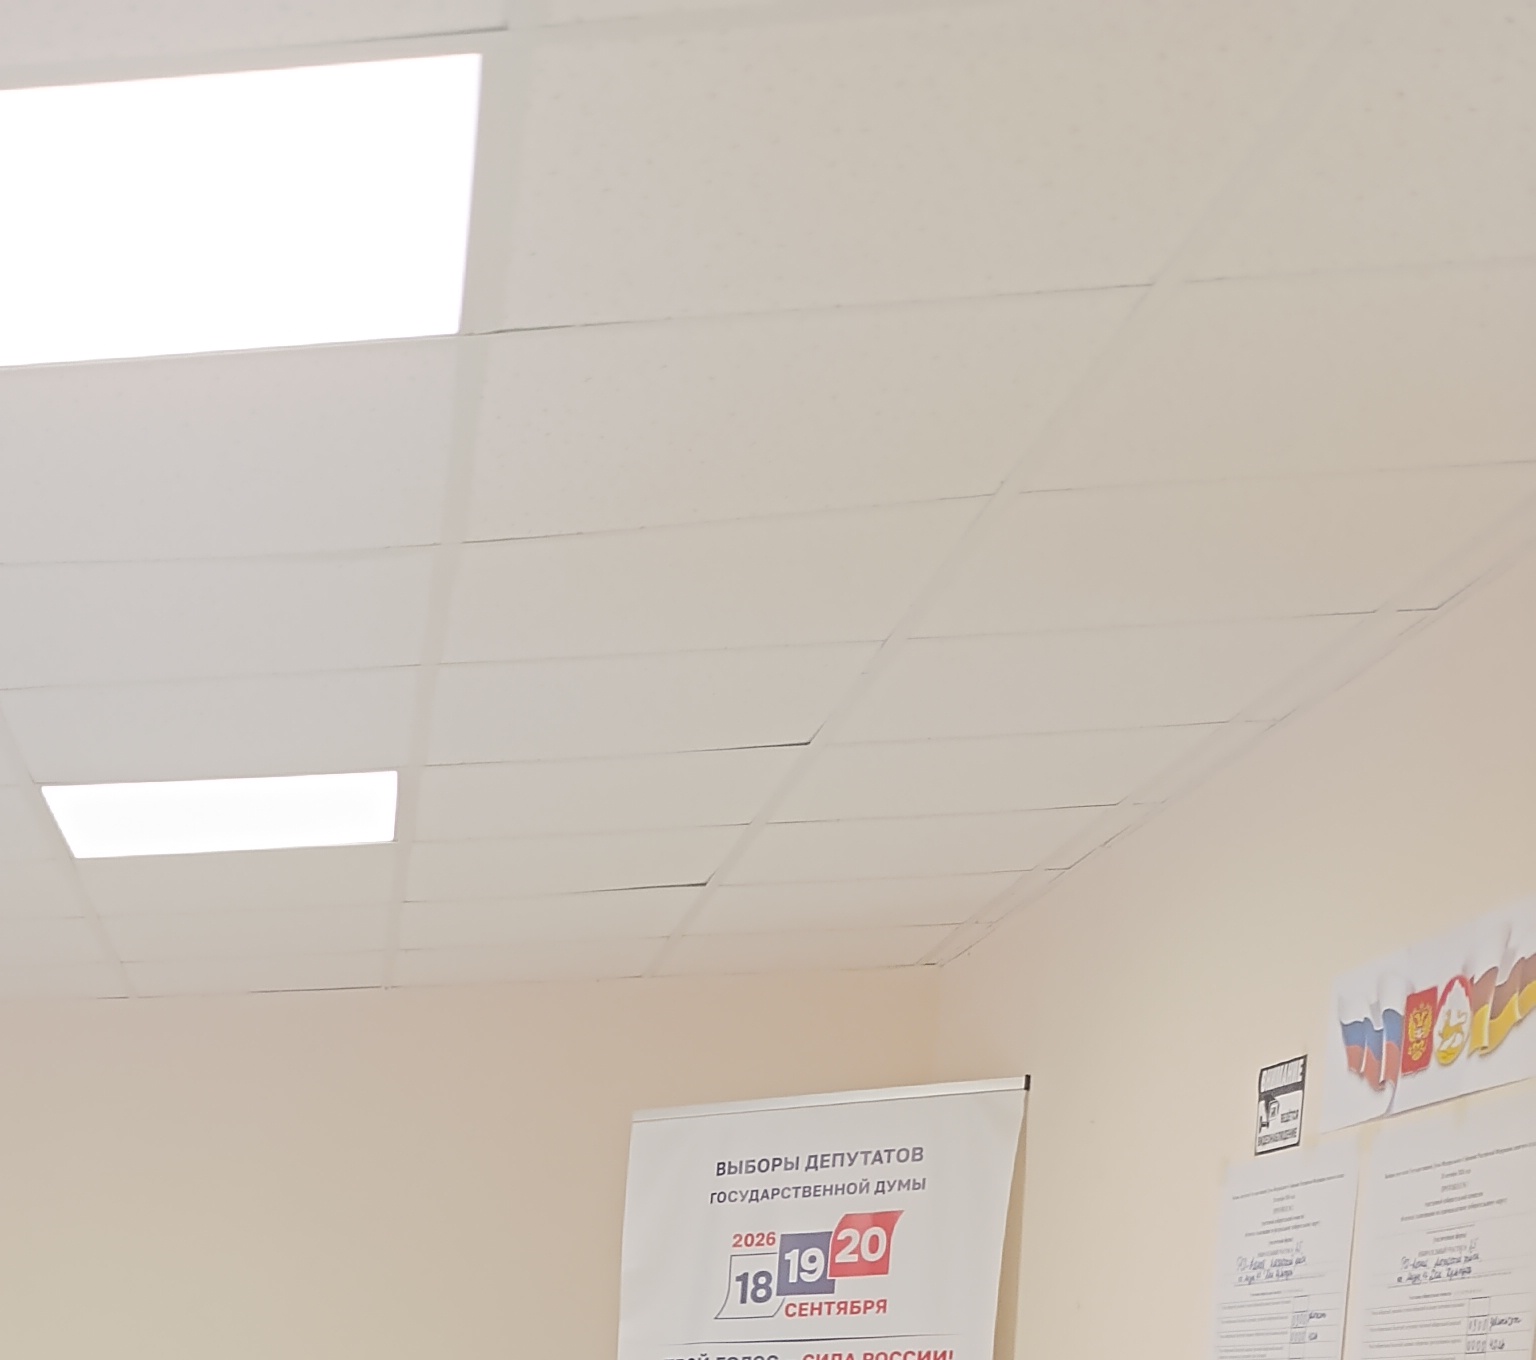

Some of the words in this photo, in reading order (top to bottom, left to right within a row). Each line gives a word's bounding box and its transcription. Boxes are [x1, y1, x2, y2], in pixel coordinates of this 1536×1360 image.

[715, 1155, 801, 1177] ВЫБОРЫ
[804, 1147, 925, 1173] ДЕПУТАТОВ
[709, 1180, 870, 1205] ГОСУДАРСТВЕННОЙ
[874, 1177, 927, 1196] ДУМЫ
[732, 1231, 776, 1249] 2026
[735, 1270, 773, 1304] 18
[784, 1247, 825, 1283] 19
[835, 1226, 887, 1264] 20
[784, 1298, 888, 1319] СЕНТЯБРЯ
